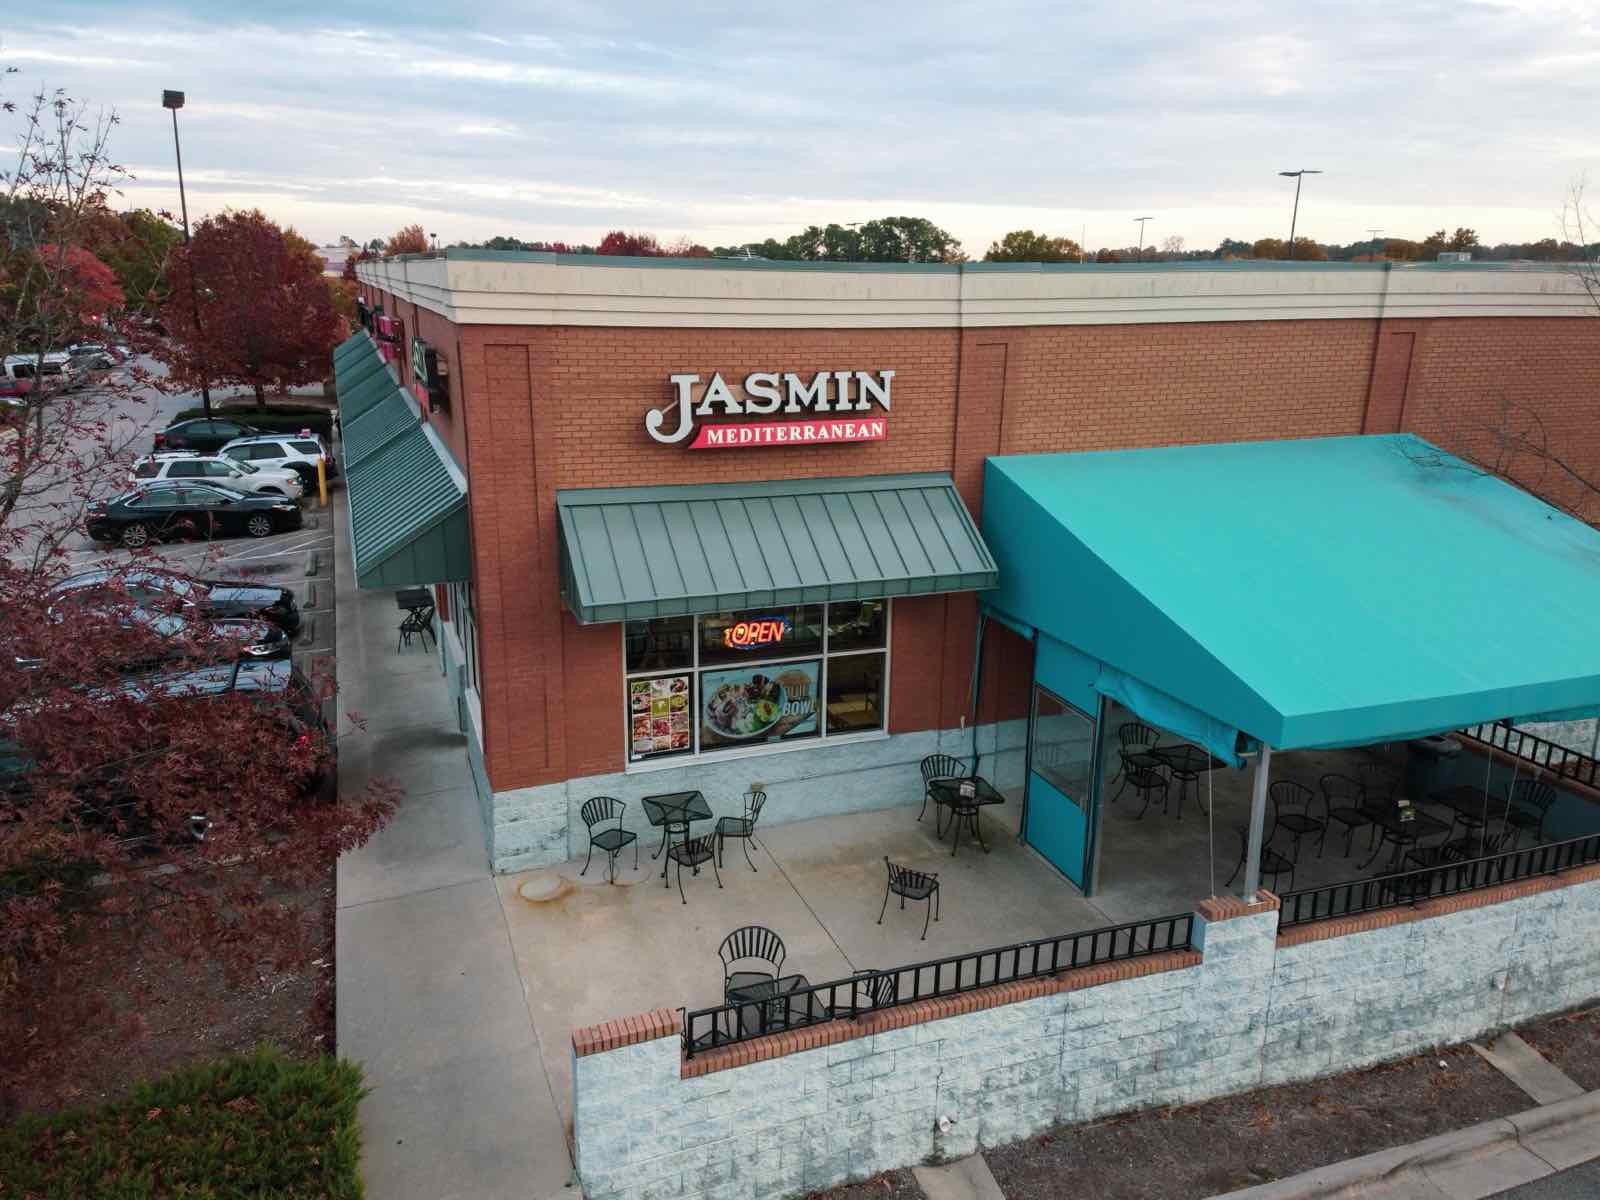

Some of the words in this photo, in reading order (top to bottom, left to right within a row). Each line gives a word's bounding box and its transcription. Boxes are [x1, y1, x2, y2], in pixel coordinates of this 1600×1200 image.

[645, 370, 896, 443] JASMIN
[706, 422, 885, 445] MEDITERRANEAN
[731, 621, 785, 645] OPEN
